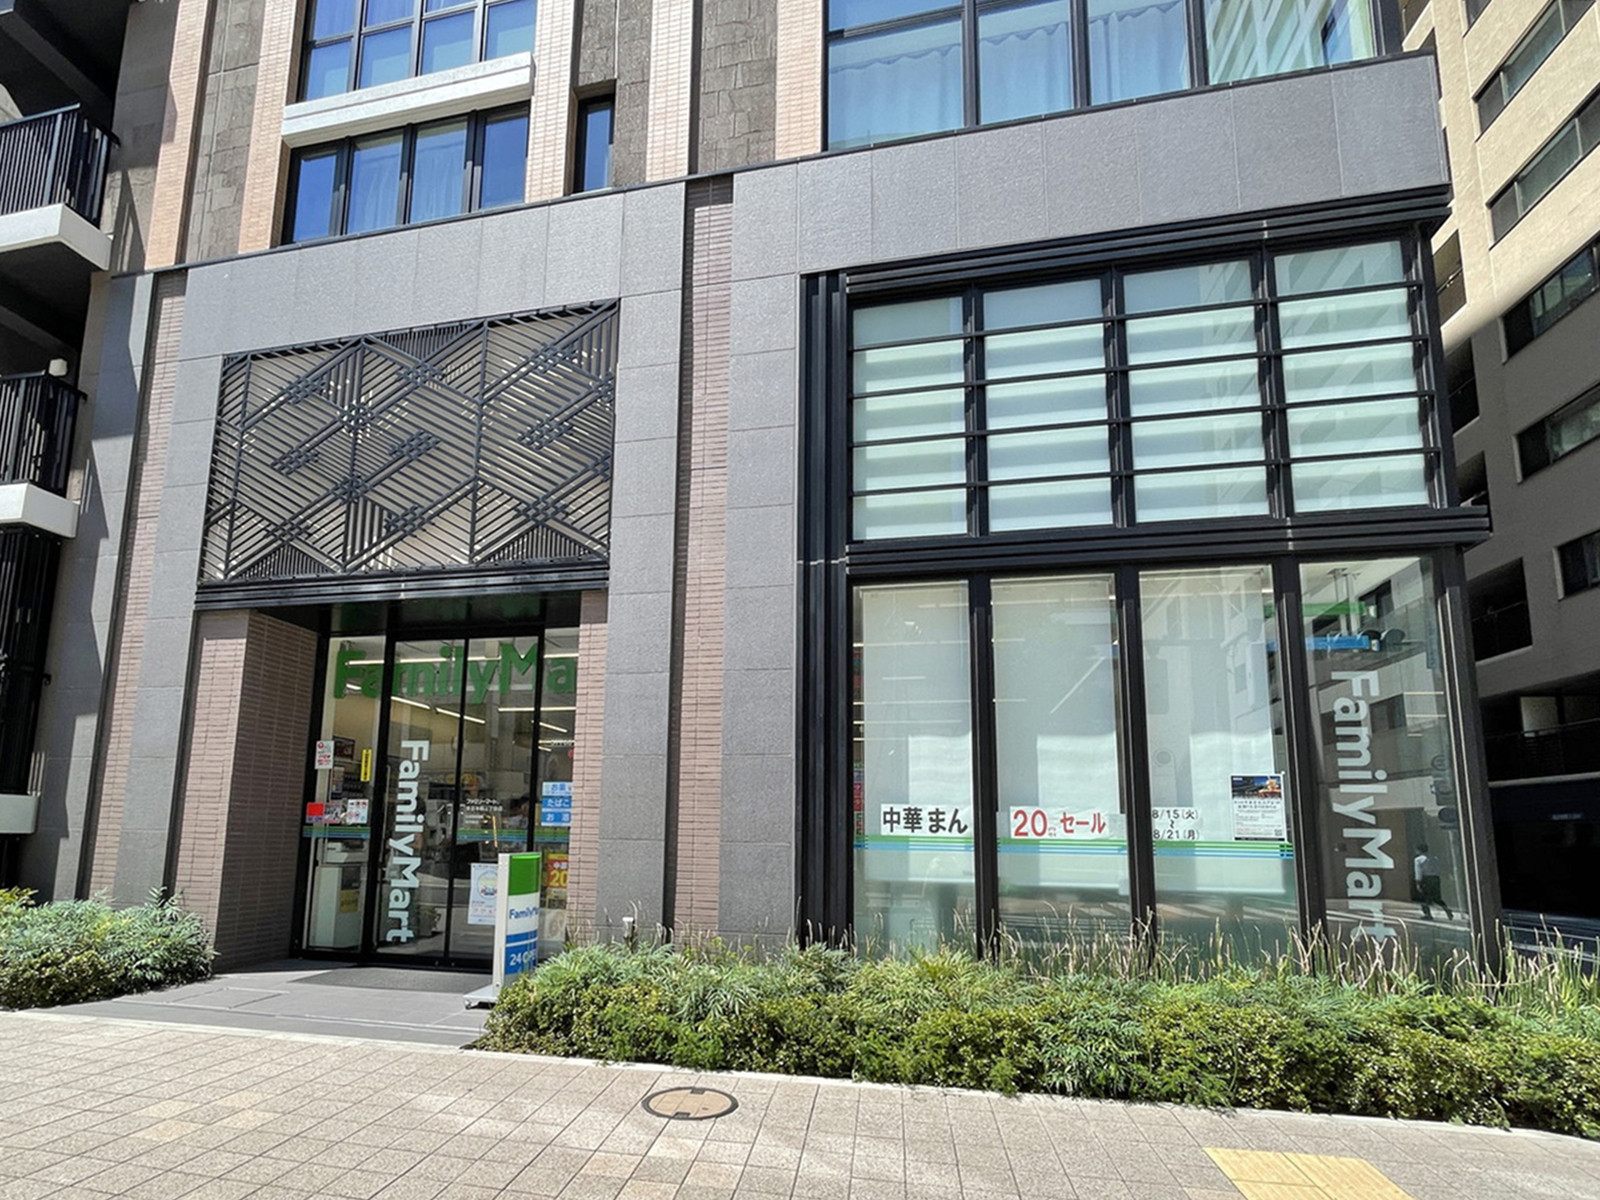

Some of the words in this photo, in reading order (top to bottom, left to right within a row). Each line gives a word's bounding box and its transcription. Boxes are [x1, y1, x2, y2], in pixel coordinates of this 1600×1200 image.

[547, 798, 570, 808] たばこ
[1331, 670, 1398, 943] FamilyMart
[883, 806, 969, 834] 中華まん
[1013, 809, 1048, 837] 20
[1060, 811, 1106, 834] セール
[386, 740, 430, 943] FamilyMart
